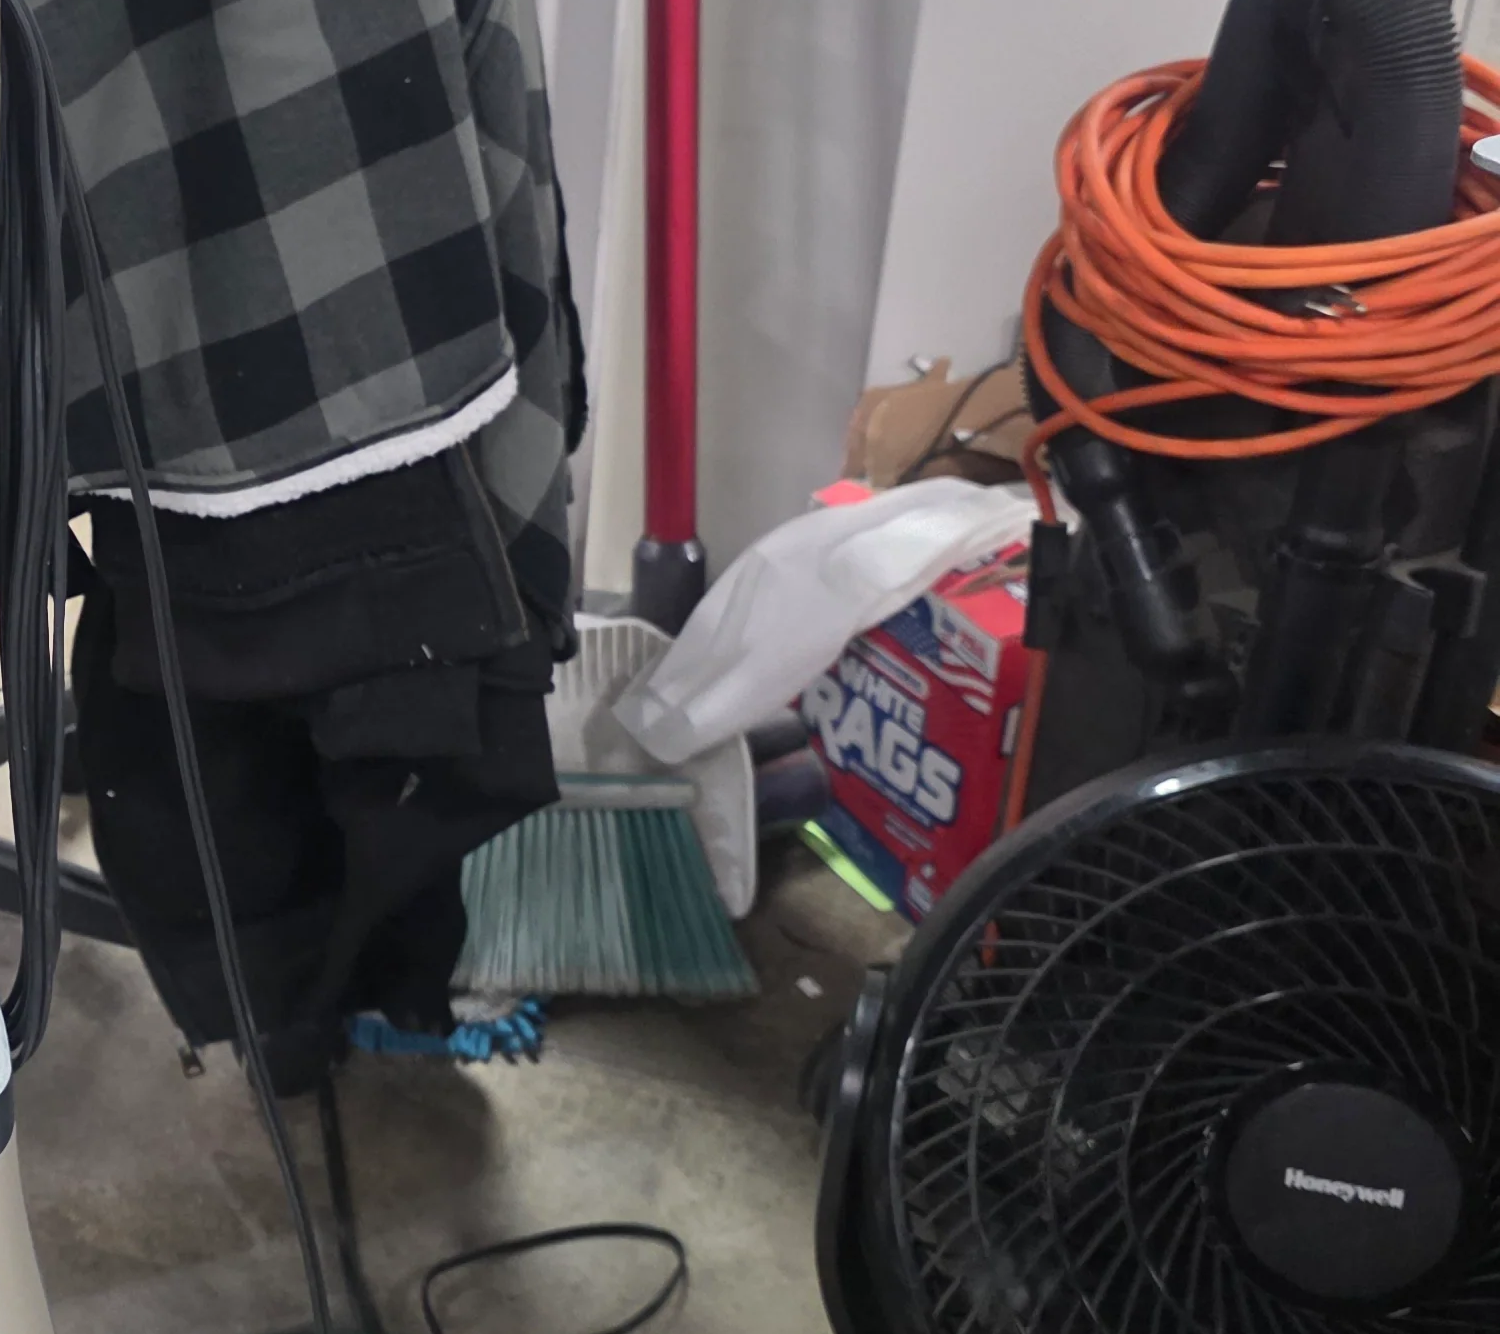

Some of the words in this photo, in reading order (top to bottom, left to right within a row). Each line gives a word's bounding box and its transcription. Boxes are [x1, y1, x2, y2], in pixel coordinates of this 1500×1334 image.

[836, 655, 926, 736] WHITE
[801, 671, 962, 823] RAGS
[1284, 1167, 1405, 1209] Honeywell
